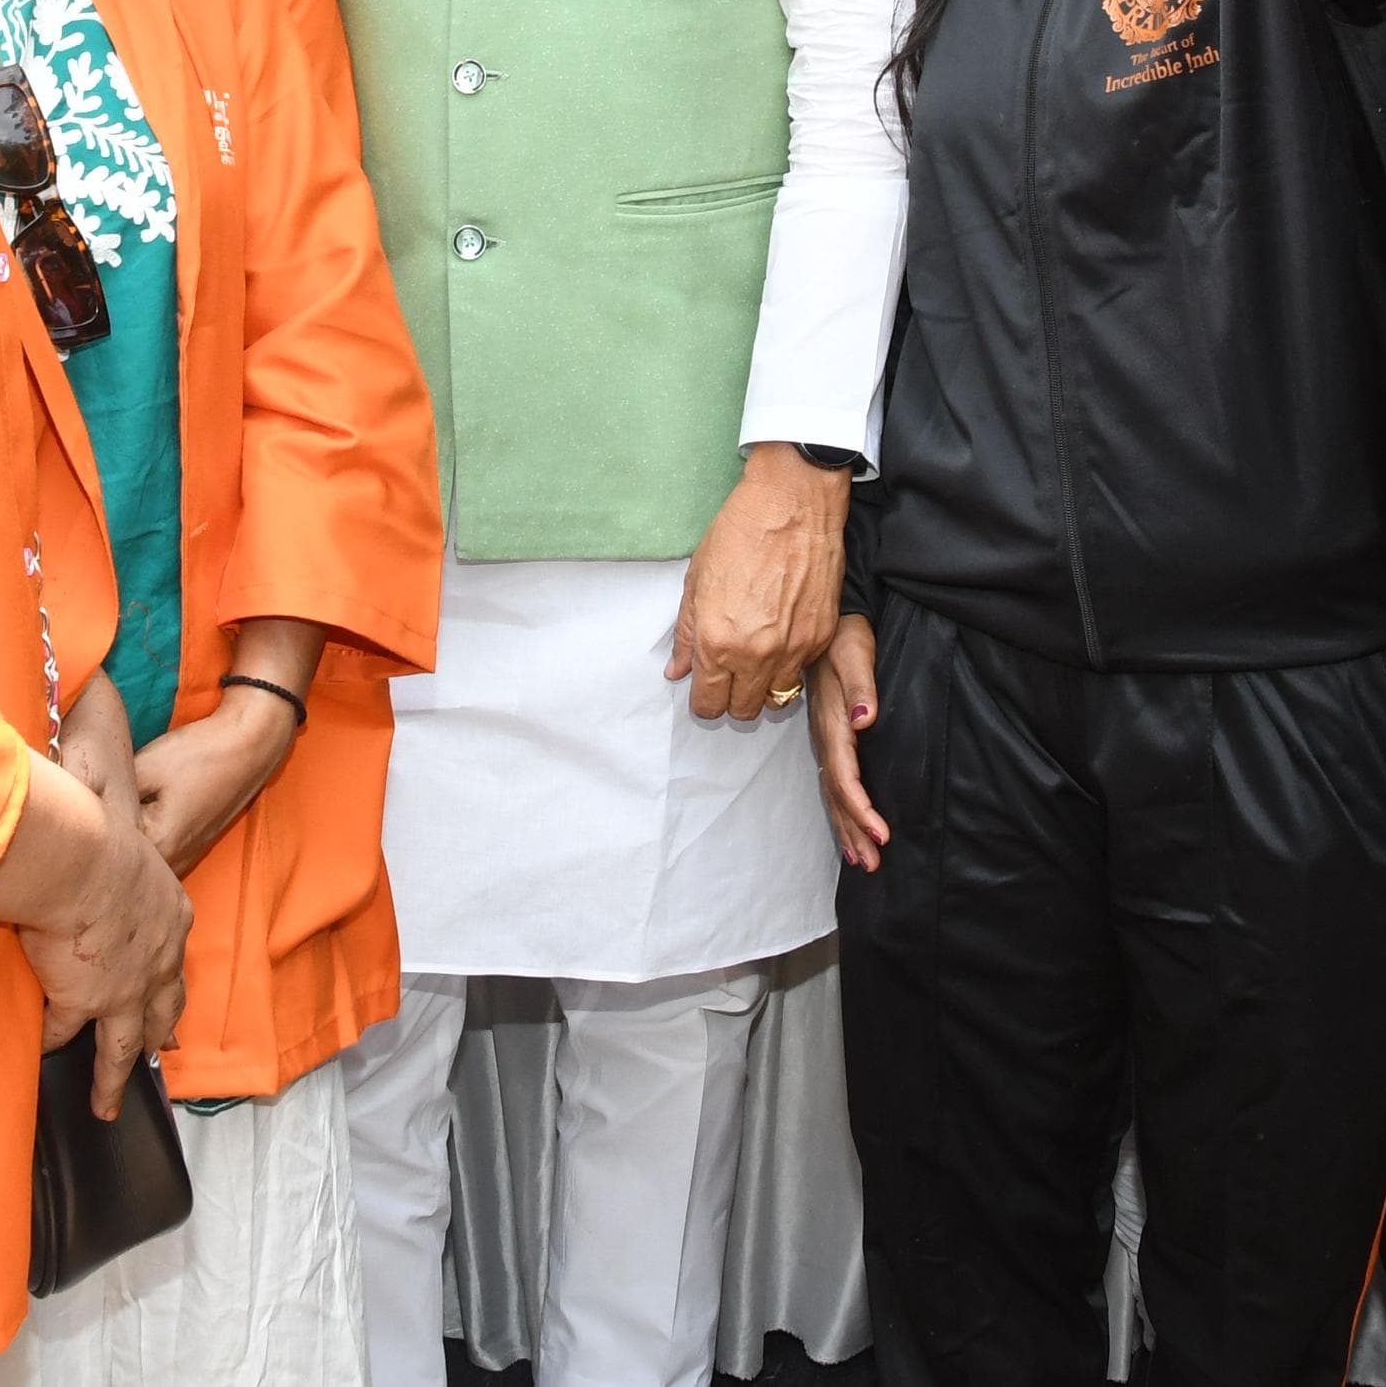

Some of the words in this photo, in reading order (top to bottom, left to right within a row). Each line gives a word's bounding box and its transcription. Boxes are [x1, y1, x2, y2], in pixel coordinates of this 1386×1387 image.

[1130, 50, 1149, 67] The
[1180, 31, 1196, 49] of
[1104, 59, 1184, 94] Incredible
